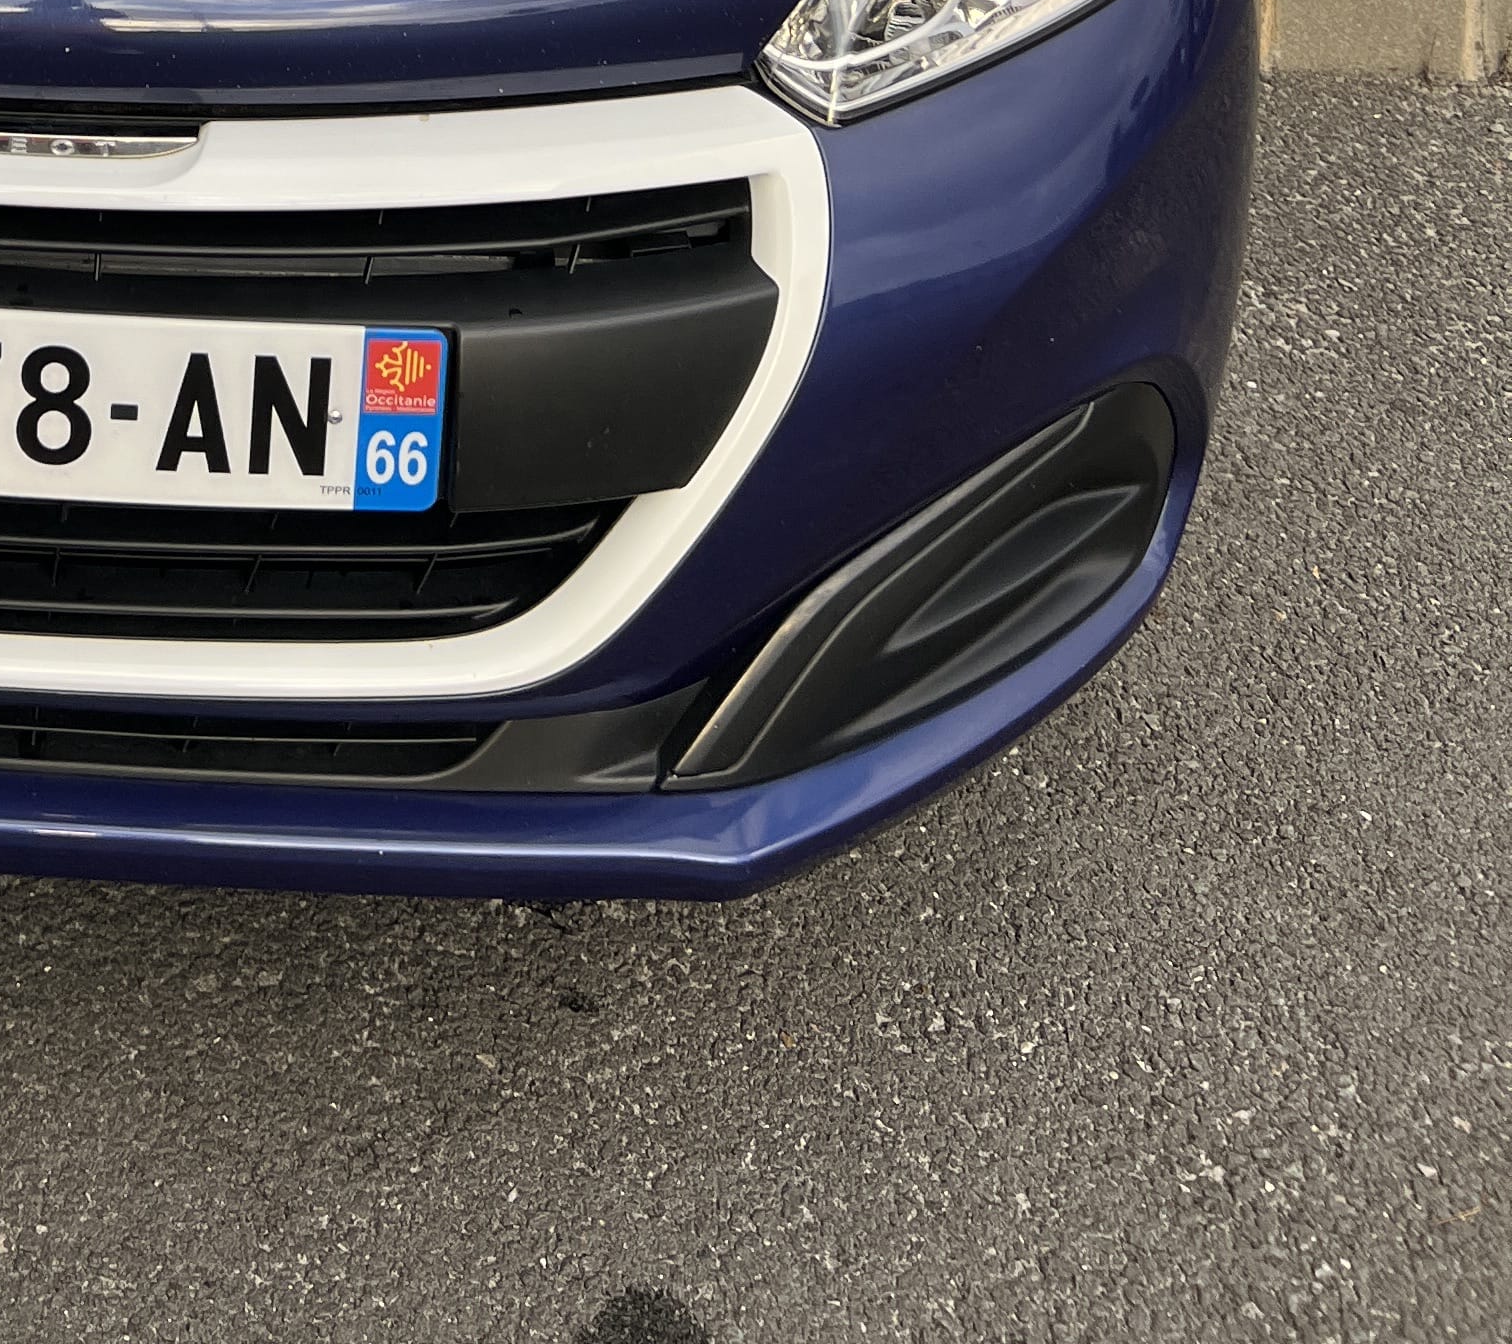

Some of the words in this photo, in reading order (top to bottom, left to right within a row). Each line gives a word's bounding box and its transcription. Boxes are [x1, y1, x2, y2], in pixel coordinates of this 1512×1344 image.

[365, 393, 436, 408] Occitanie
[365, 429, 429, 486] 66
[320, 484, 351, 495] TPPR
